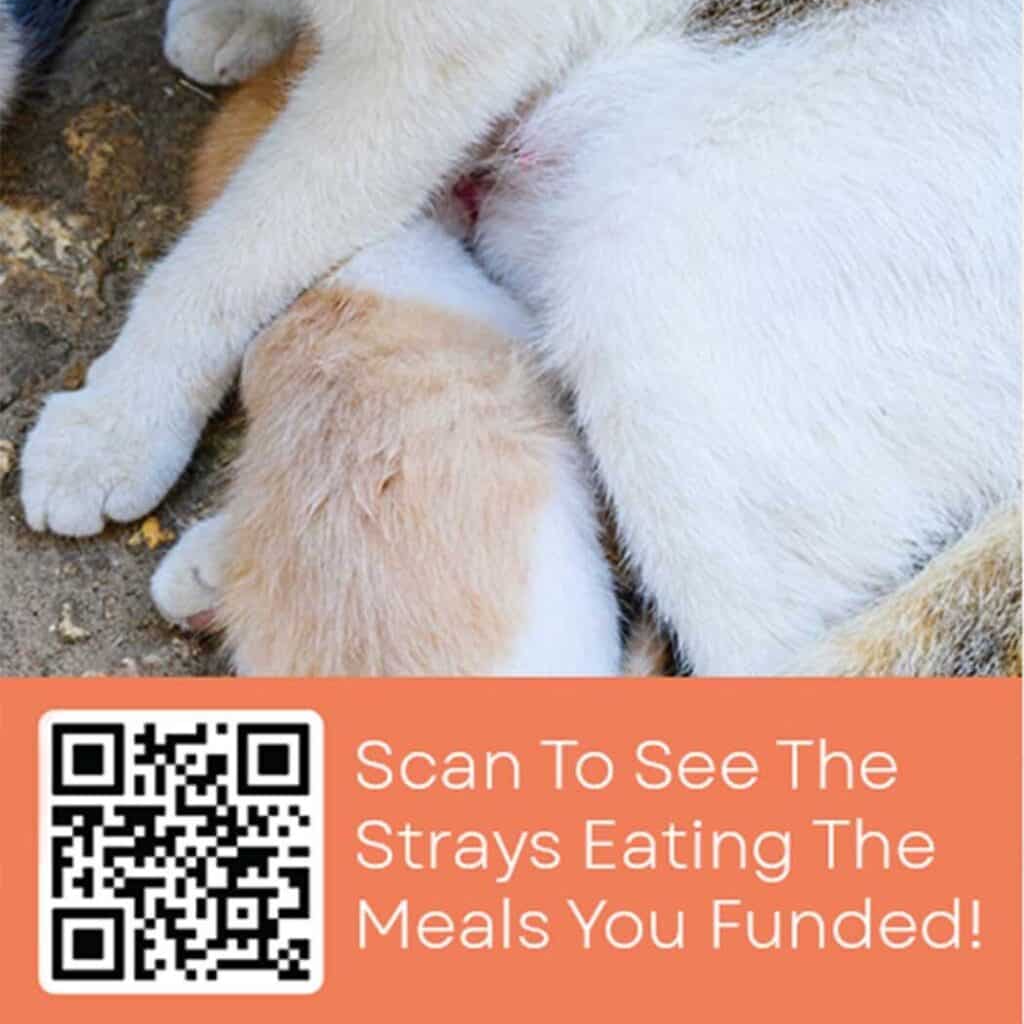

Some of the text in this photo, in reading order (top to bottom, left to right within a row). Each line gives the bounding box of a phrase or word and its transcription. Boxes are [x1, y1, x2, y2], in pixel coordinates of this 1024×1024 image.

[357, 738, 897, 790] Scan To See The
[357, 818, 935, 883] Strays Eating The
[359, 897, 980, 949] Meals You Funded!
